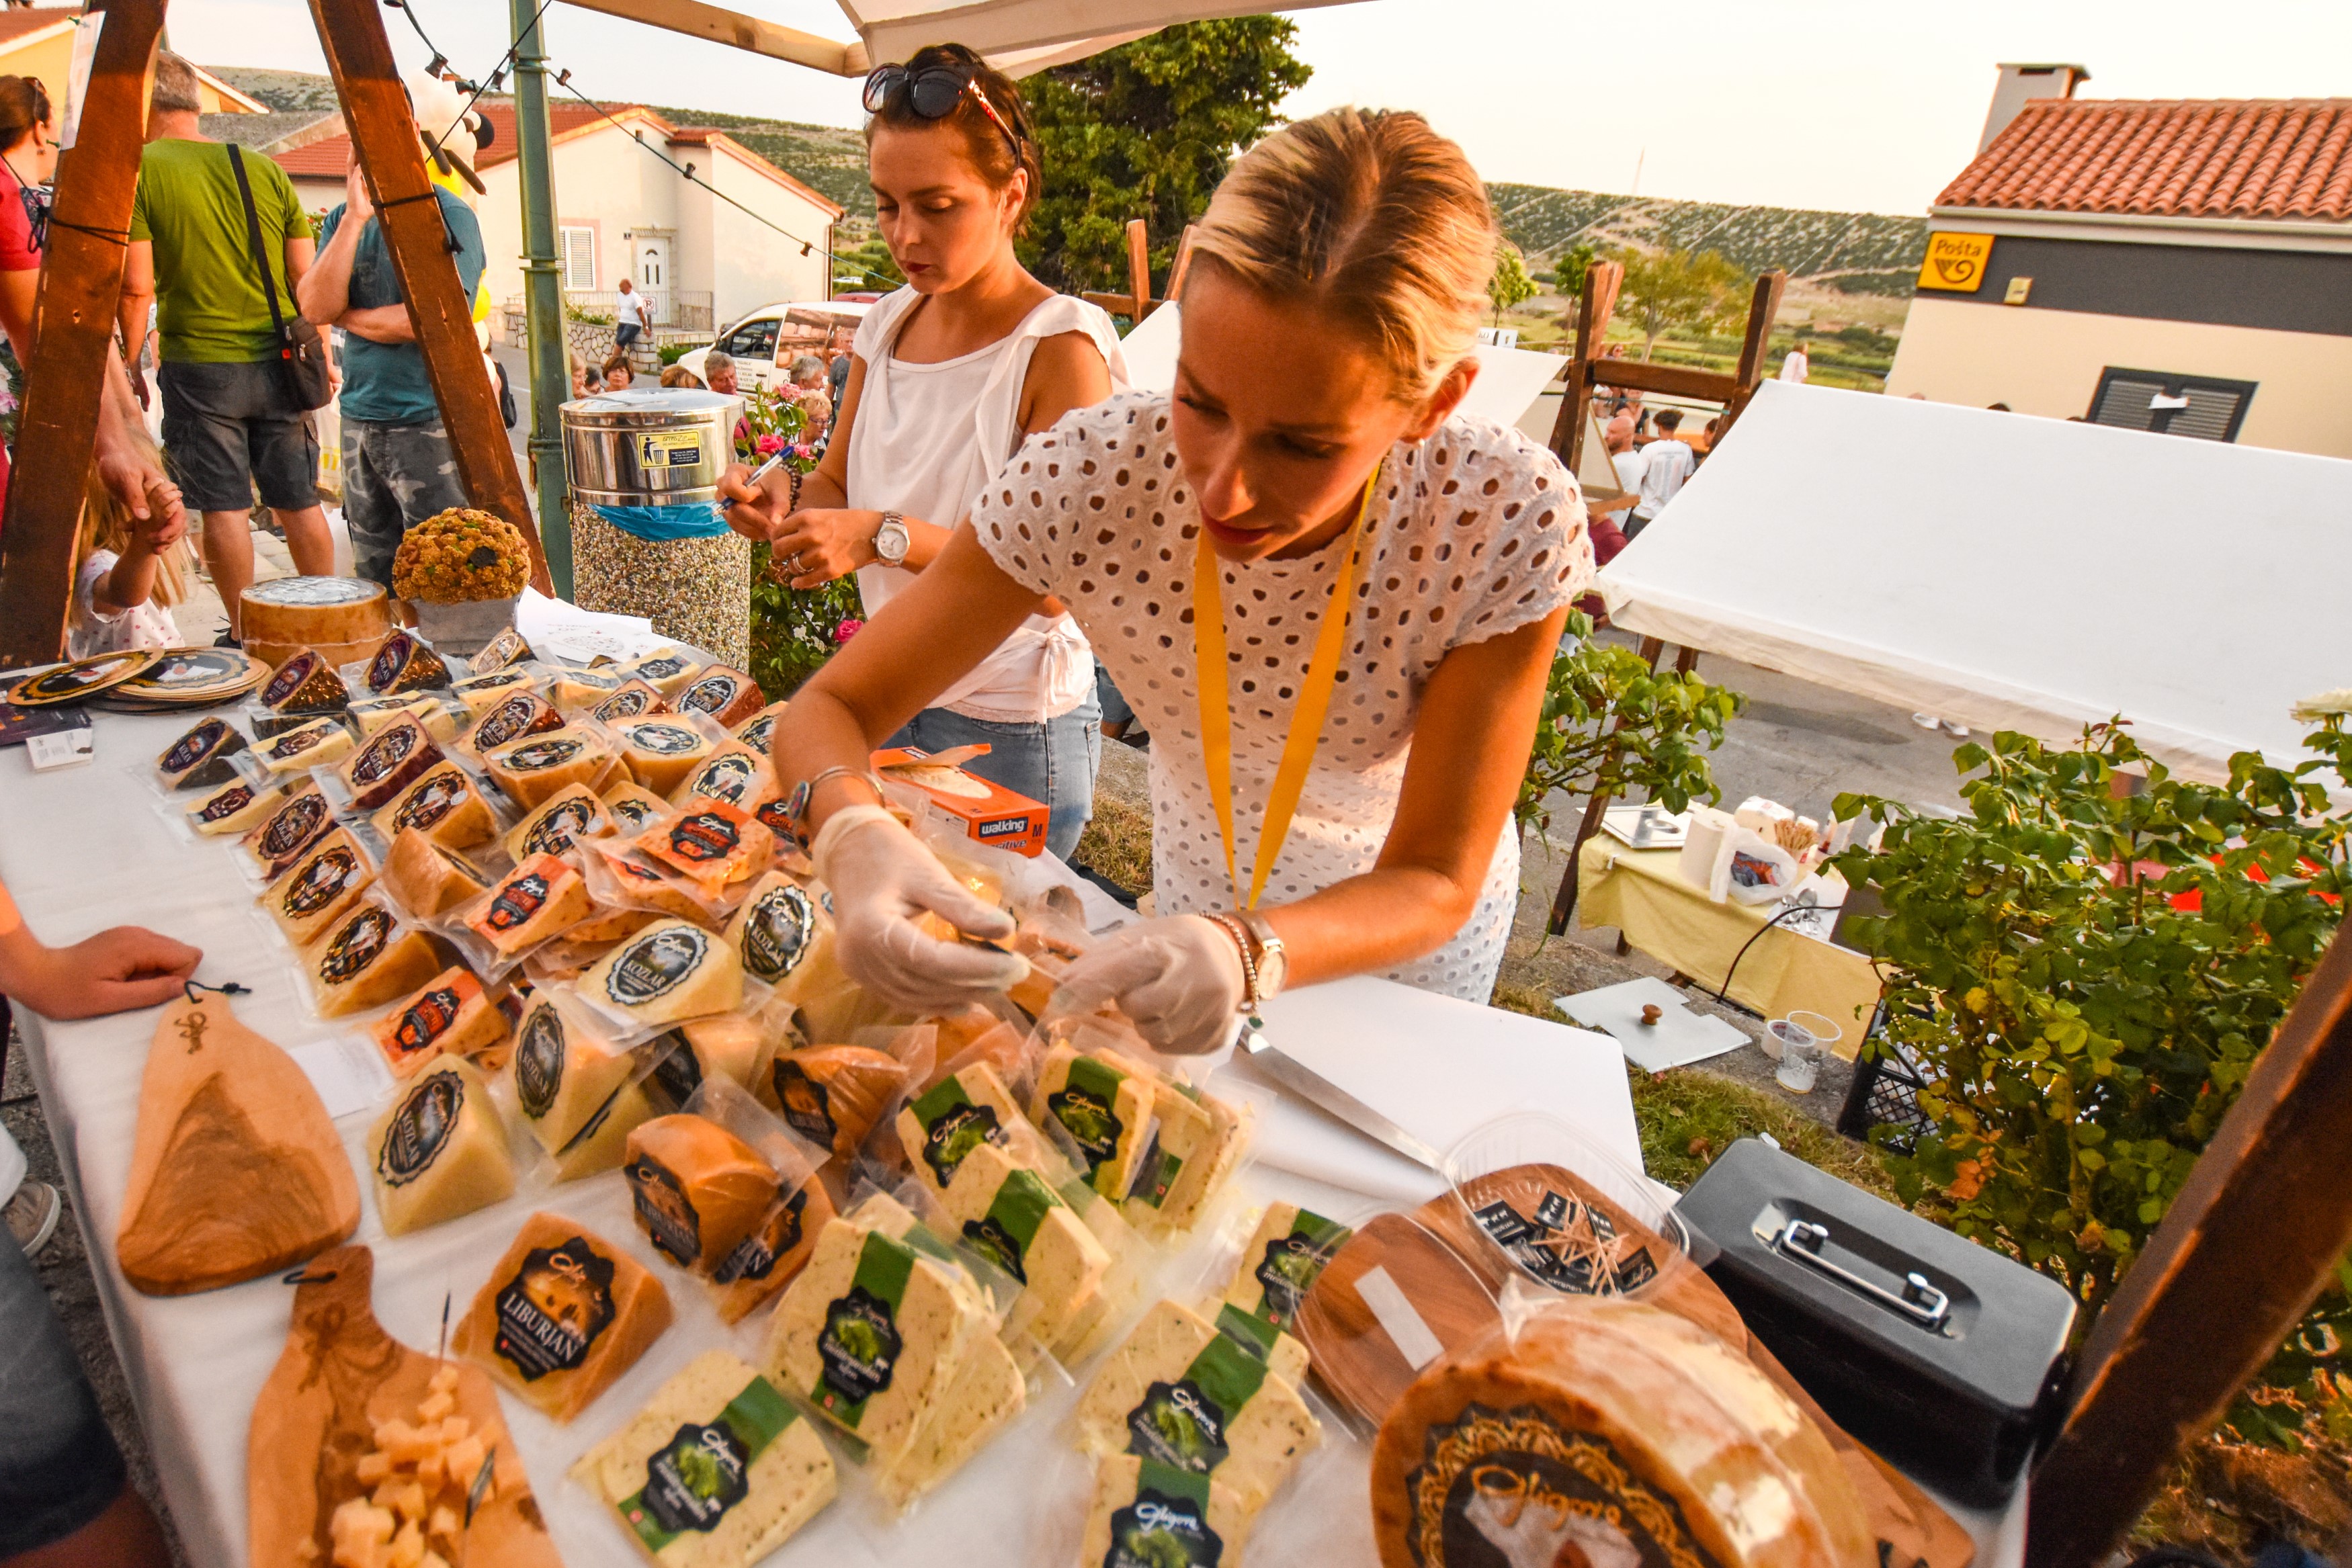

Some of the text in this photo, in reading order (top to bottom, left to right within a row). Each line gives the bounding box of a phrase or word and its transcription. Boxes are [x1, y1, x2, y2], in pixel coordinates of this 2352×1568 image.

[1935, 239, 1982, 257] Pošta
[378, 656, 391, 681] KOLAN
[273, 679, 290, 693] KOLAN
[177, 743, 194, 763] KOLAN
[981, 818, 1026, 836] walking
[1032, 824, 1043, 837] M
[624, 959, 667, 989] KOZLAR
[503, 1292, 580, 1362] LIBURJAN
[1471, 1464, 1632, 1537] Gligora
